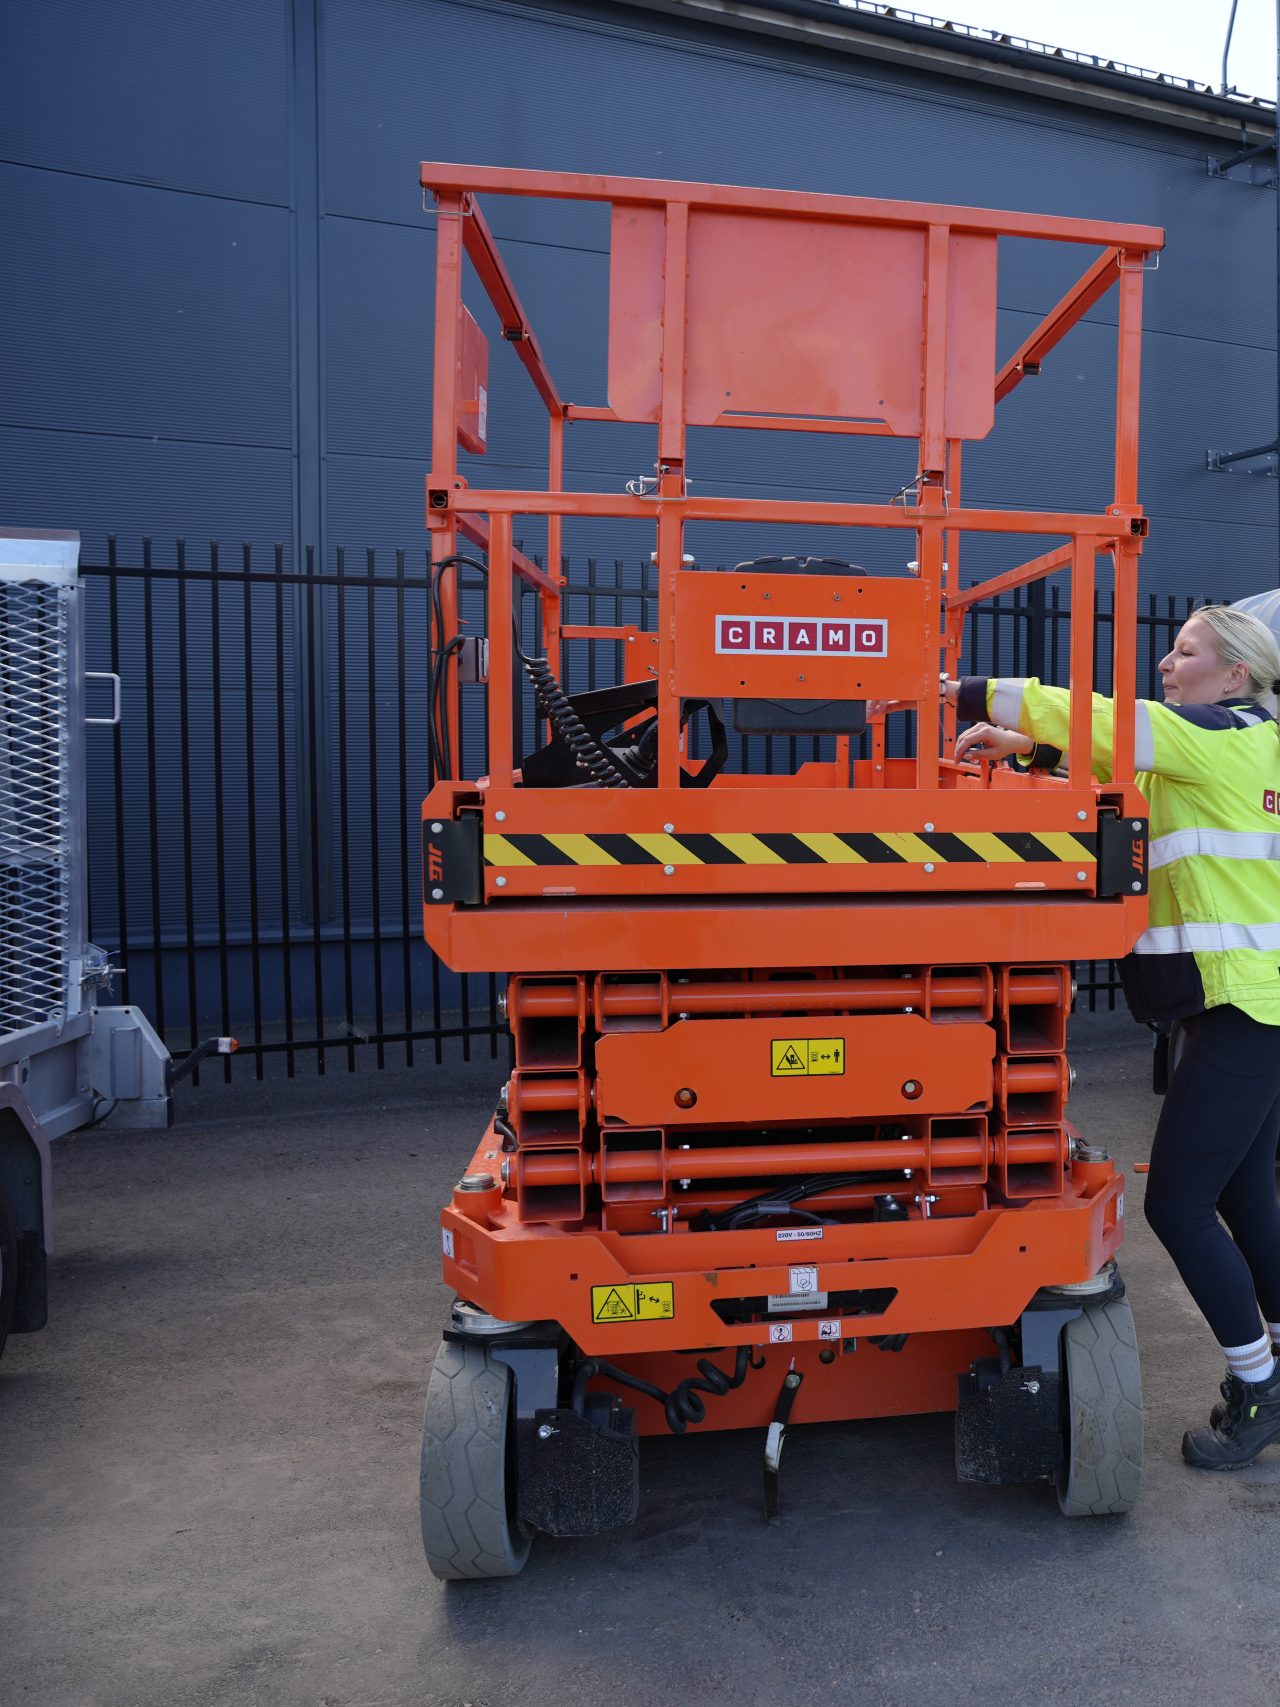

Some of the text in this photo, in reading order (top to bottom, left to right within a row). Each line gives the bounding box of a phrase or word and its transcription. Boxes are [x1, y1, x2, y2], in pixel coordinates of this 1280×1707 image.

[728, 627, 876, 646] CRAMO
[428, 842, 443, 881] JLG
[1131, 839, 1144, 875] JLG
